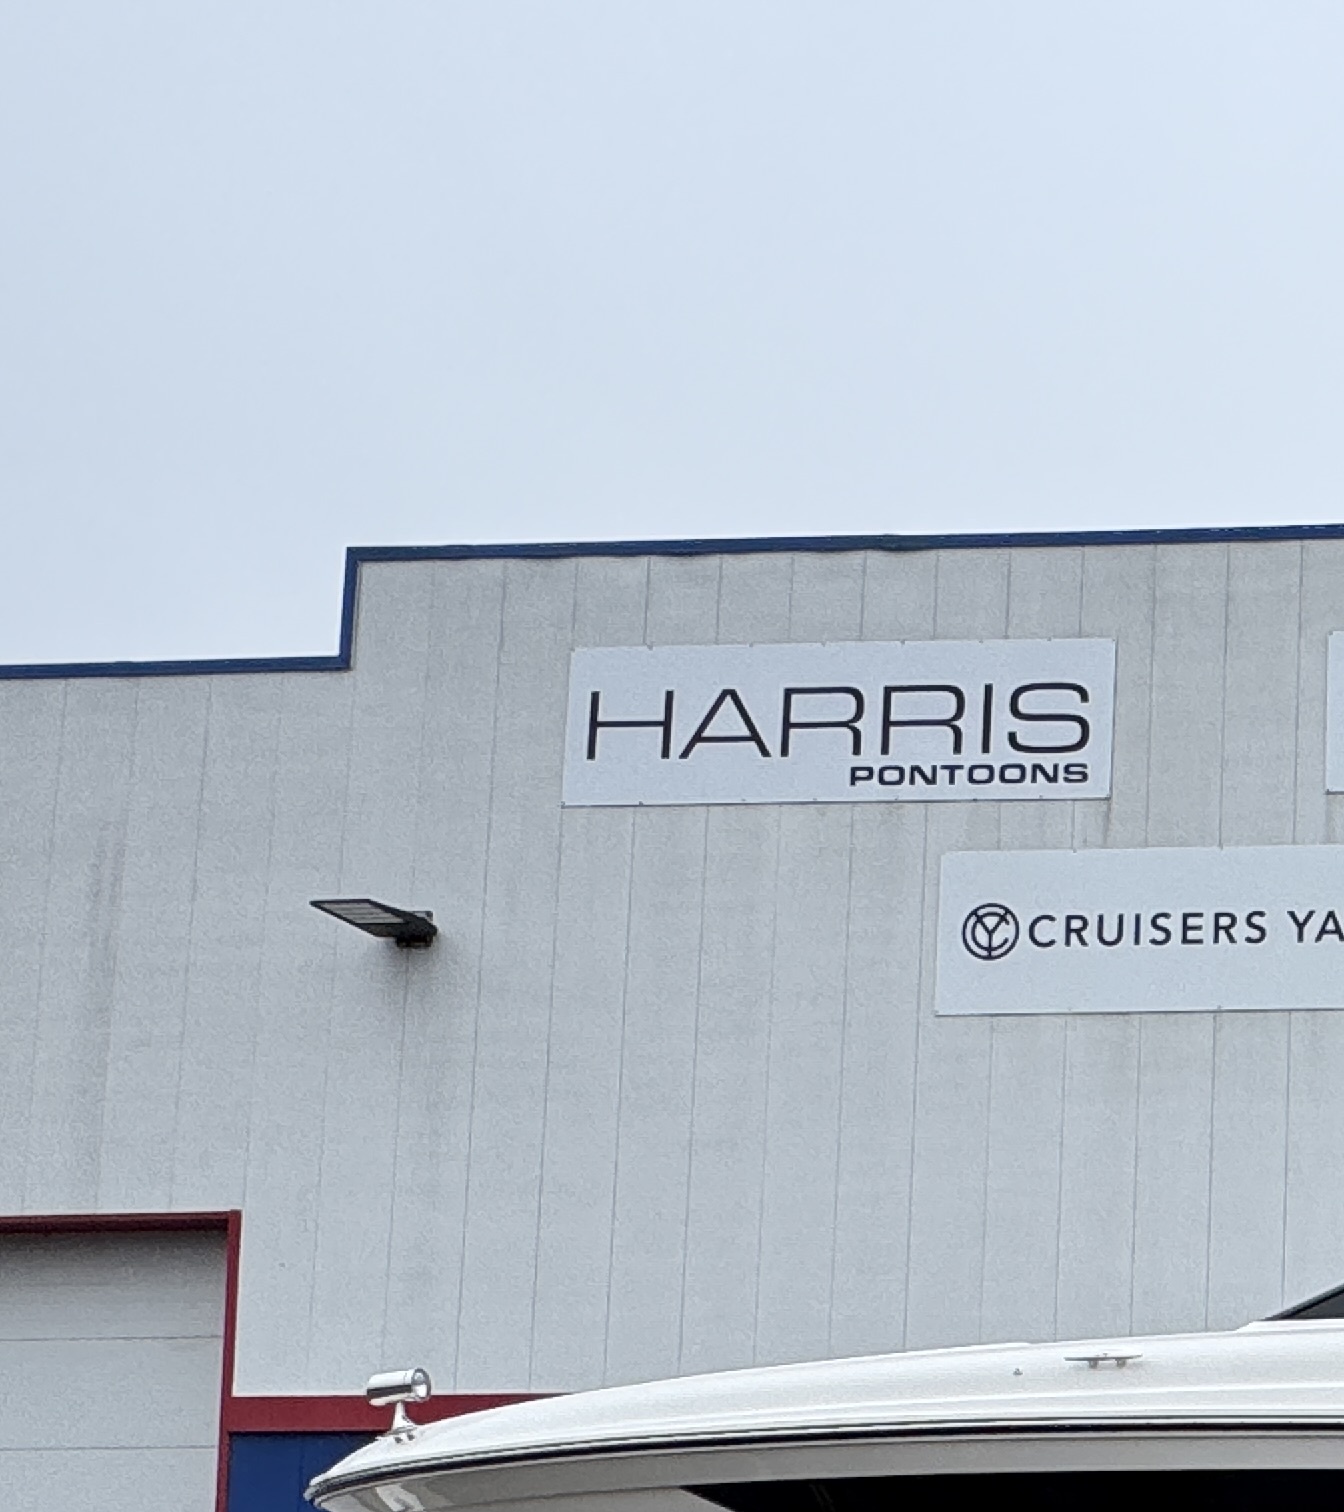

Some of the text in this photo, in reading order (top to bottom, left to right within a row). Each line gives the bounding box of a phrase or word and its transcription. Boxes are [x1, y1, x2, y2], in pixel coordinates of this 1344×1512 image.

[586, 682, 1091, 761] HARRIS
[849, 762, 1089, 787] PONTOONS
[1028, 910, 1268, 948] CRUISERS
